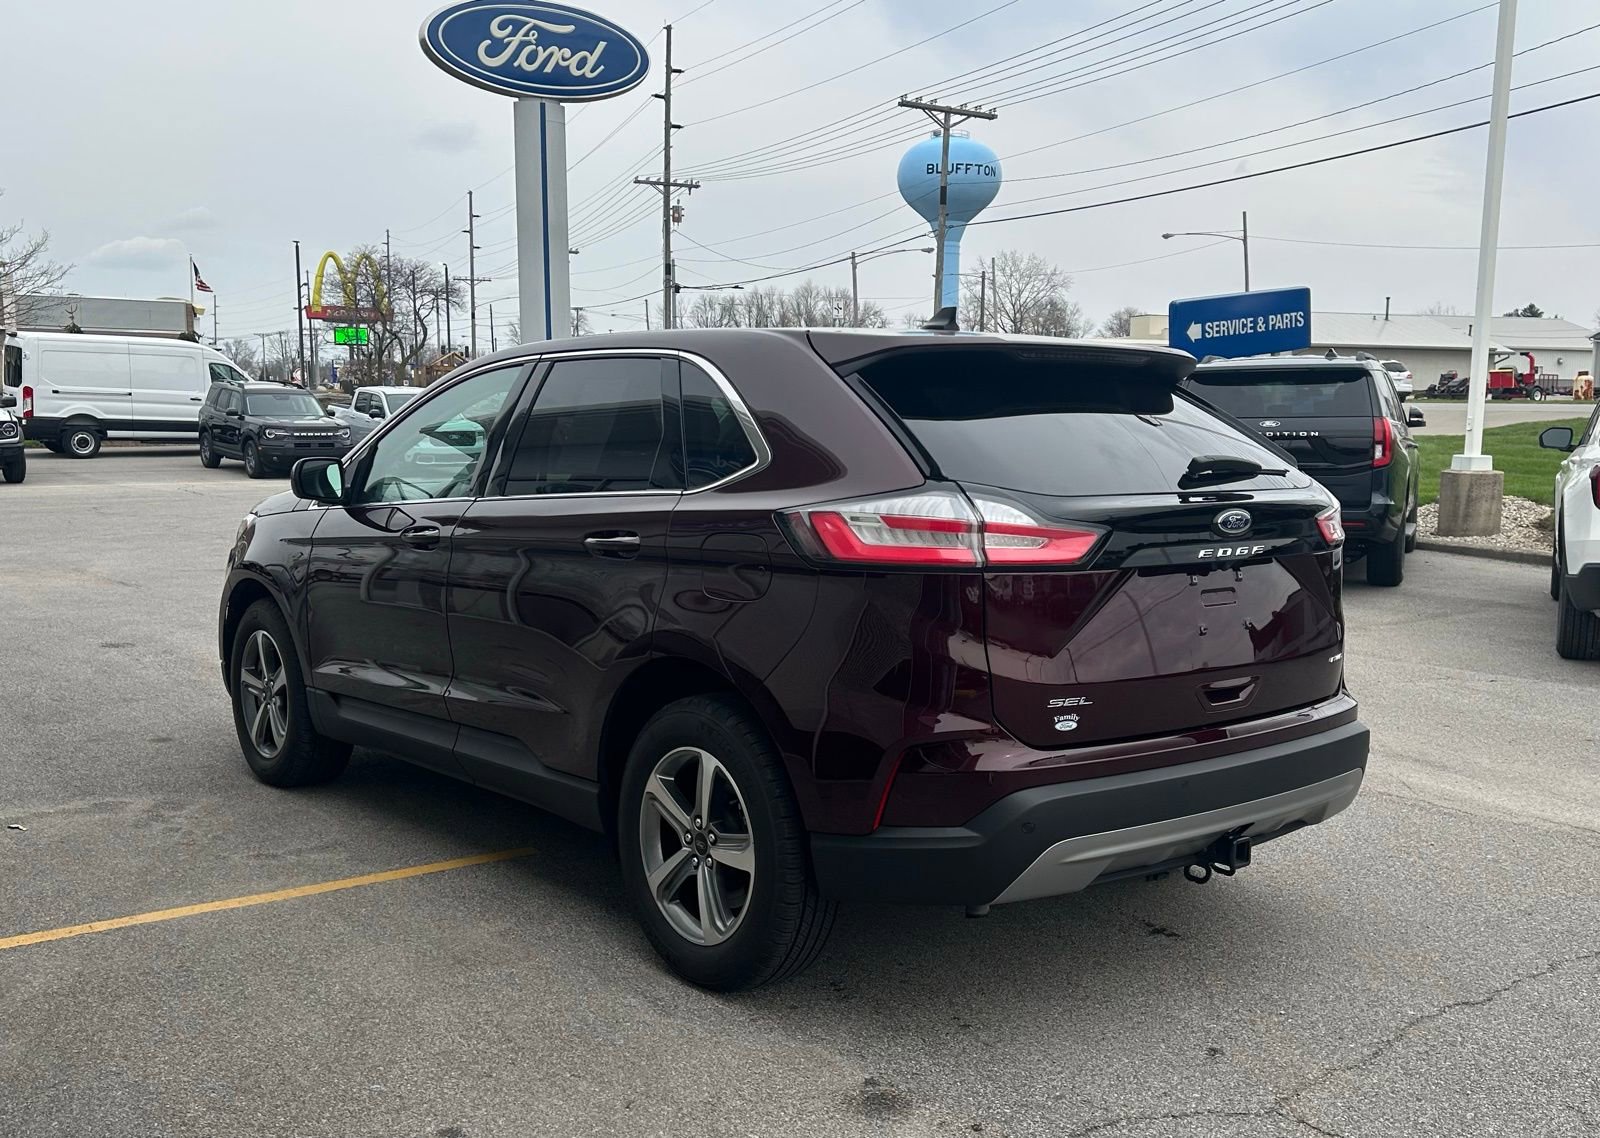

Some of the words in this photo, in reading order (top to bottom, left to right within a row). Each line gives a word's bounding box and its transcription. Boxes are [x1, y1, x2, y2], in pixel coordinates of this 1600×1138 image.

[477, 14, 608, 79] Ford
[926, 163, 997, 177] BLUFFTON
[1205, 317, 1254, 339] SERVICE
[1257, 316, 1266, 332] &
[1269, 311, 1305, 331] PARTS
[1227, 515, 1246, 528] Ford
[1198, 545, 1265, 559] EDGE
[1047, 696, 1094, 708] SEL
[1053, 713, 1081, 723] Family
